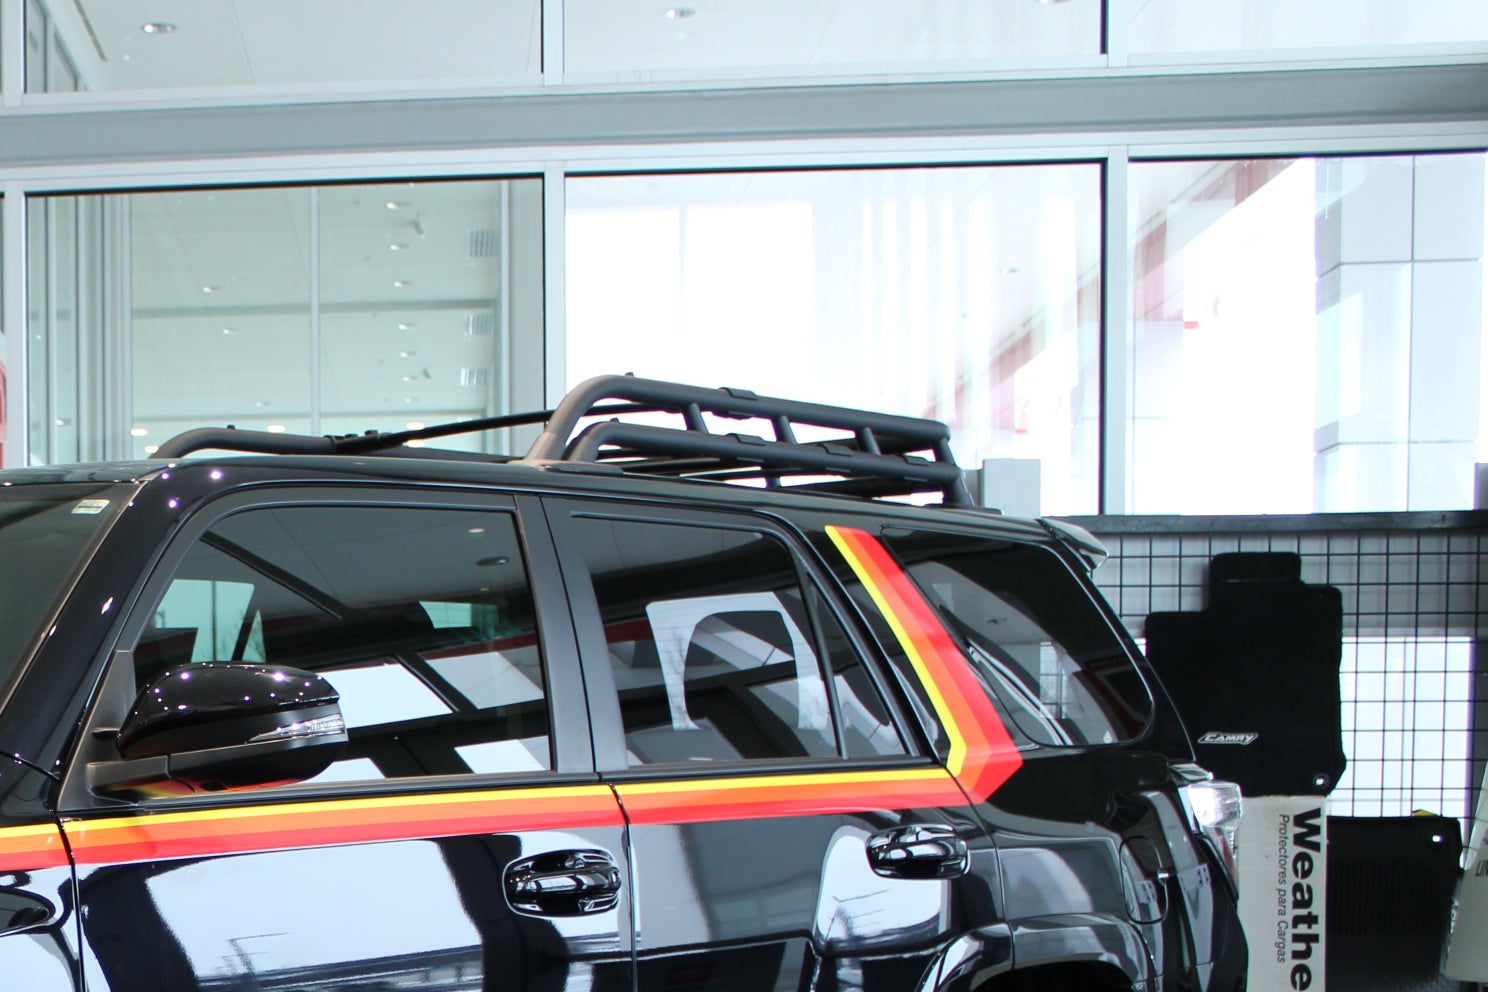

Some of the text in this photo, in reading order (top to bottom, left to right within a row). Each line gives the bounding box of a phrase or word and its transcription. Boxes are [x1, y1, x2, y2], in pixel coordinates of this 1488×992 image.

[1203, 733, 1256, 744] CAMRY
[1274, 813, 1290, 964] Protectores para Cargas
